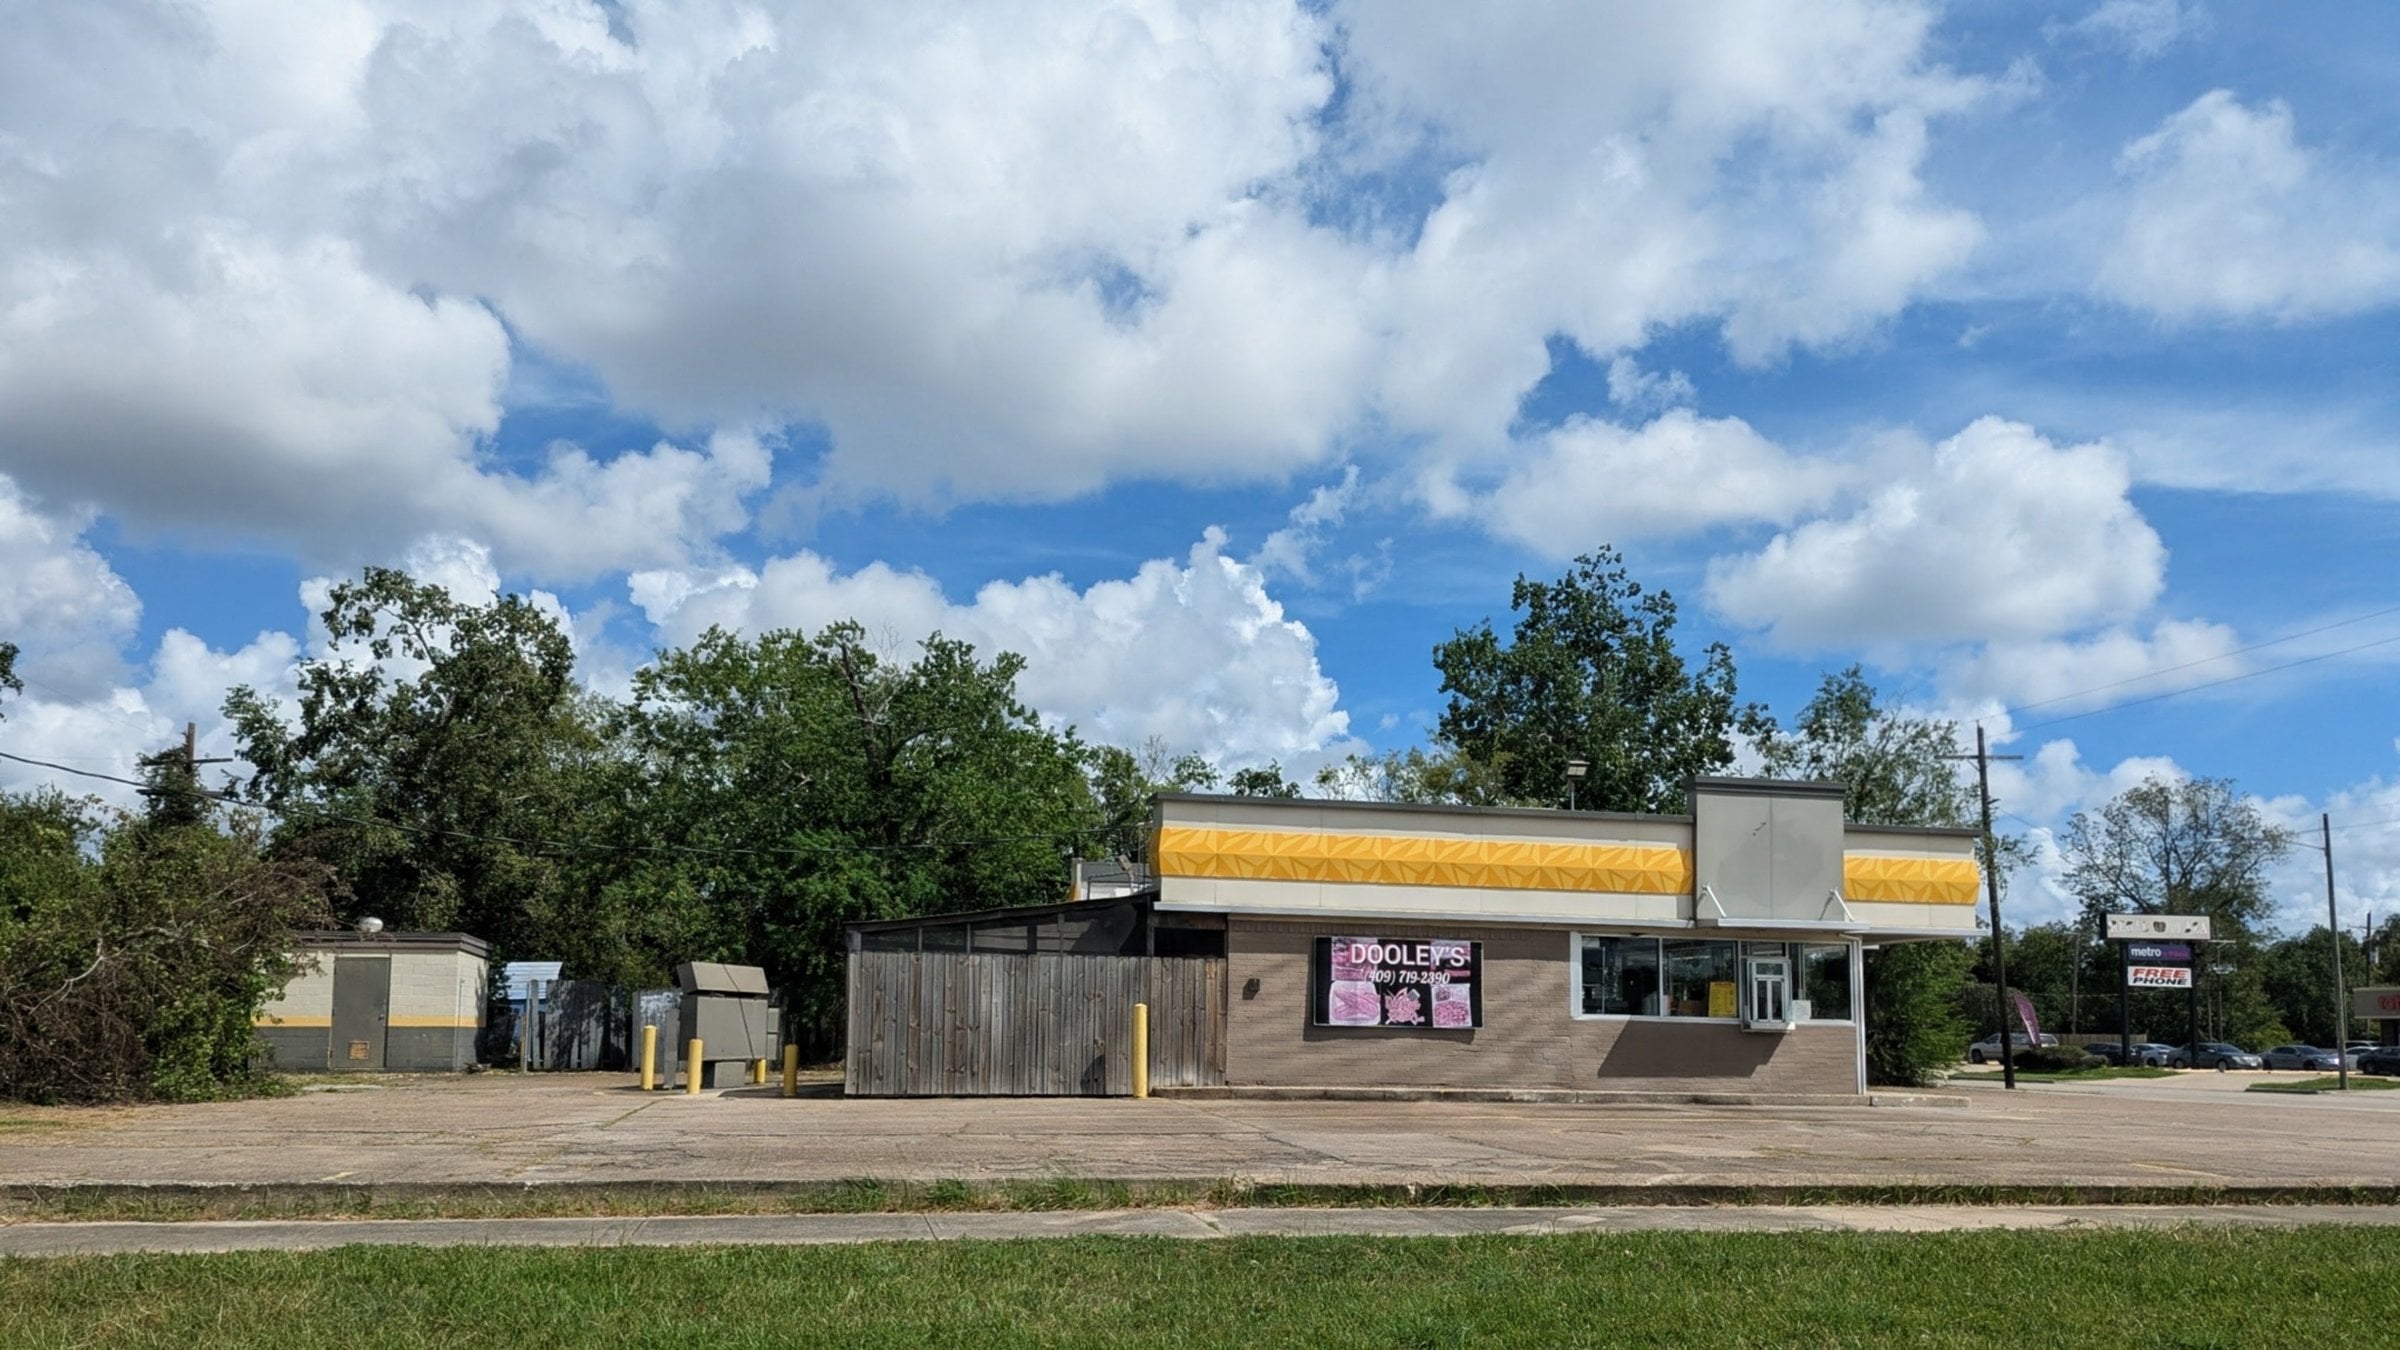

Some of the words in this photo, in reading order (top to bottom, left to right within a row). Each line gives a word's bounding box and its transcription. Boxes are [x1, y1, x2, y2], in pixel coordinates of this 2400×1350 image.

[1351, 944, 1465, 967] DOOLEY'S
[2131, 946, 2162, 957] metro
[1364, 969, 1396, 986] (409)
[2133, 968, 2188, 978] FREE
[2133, 977, 2187, 985] PHONE
